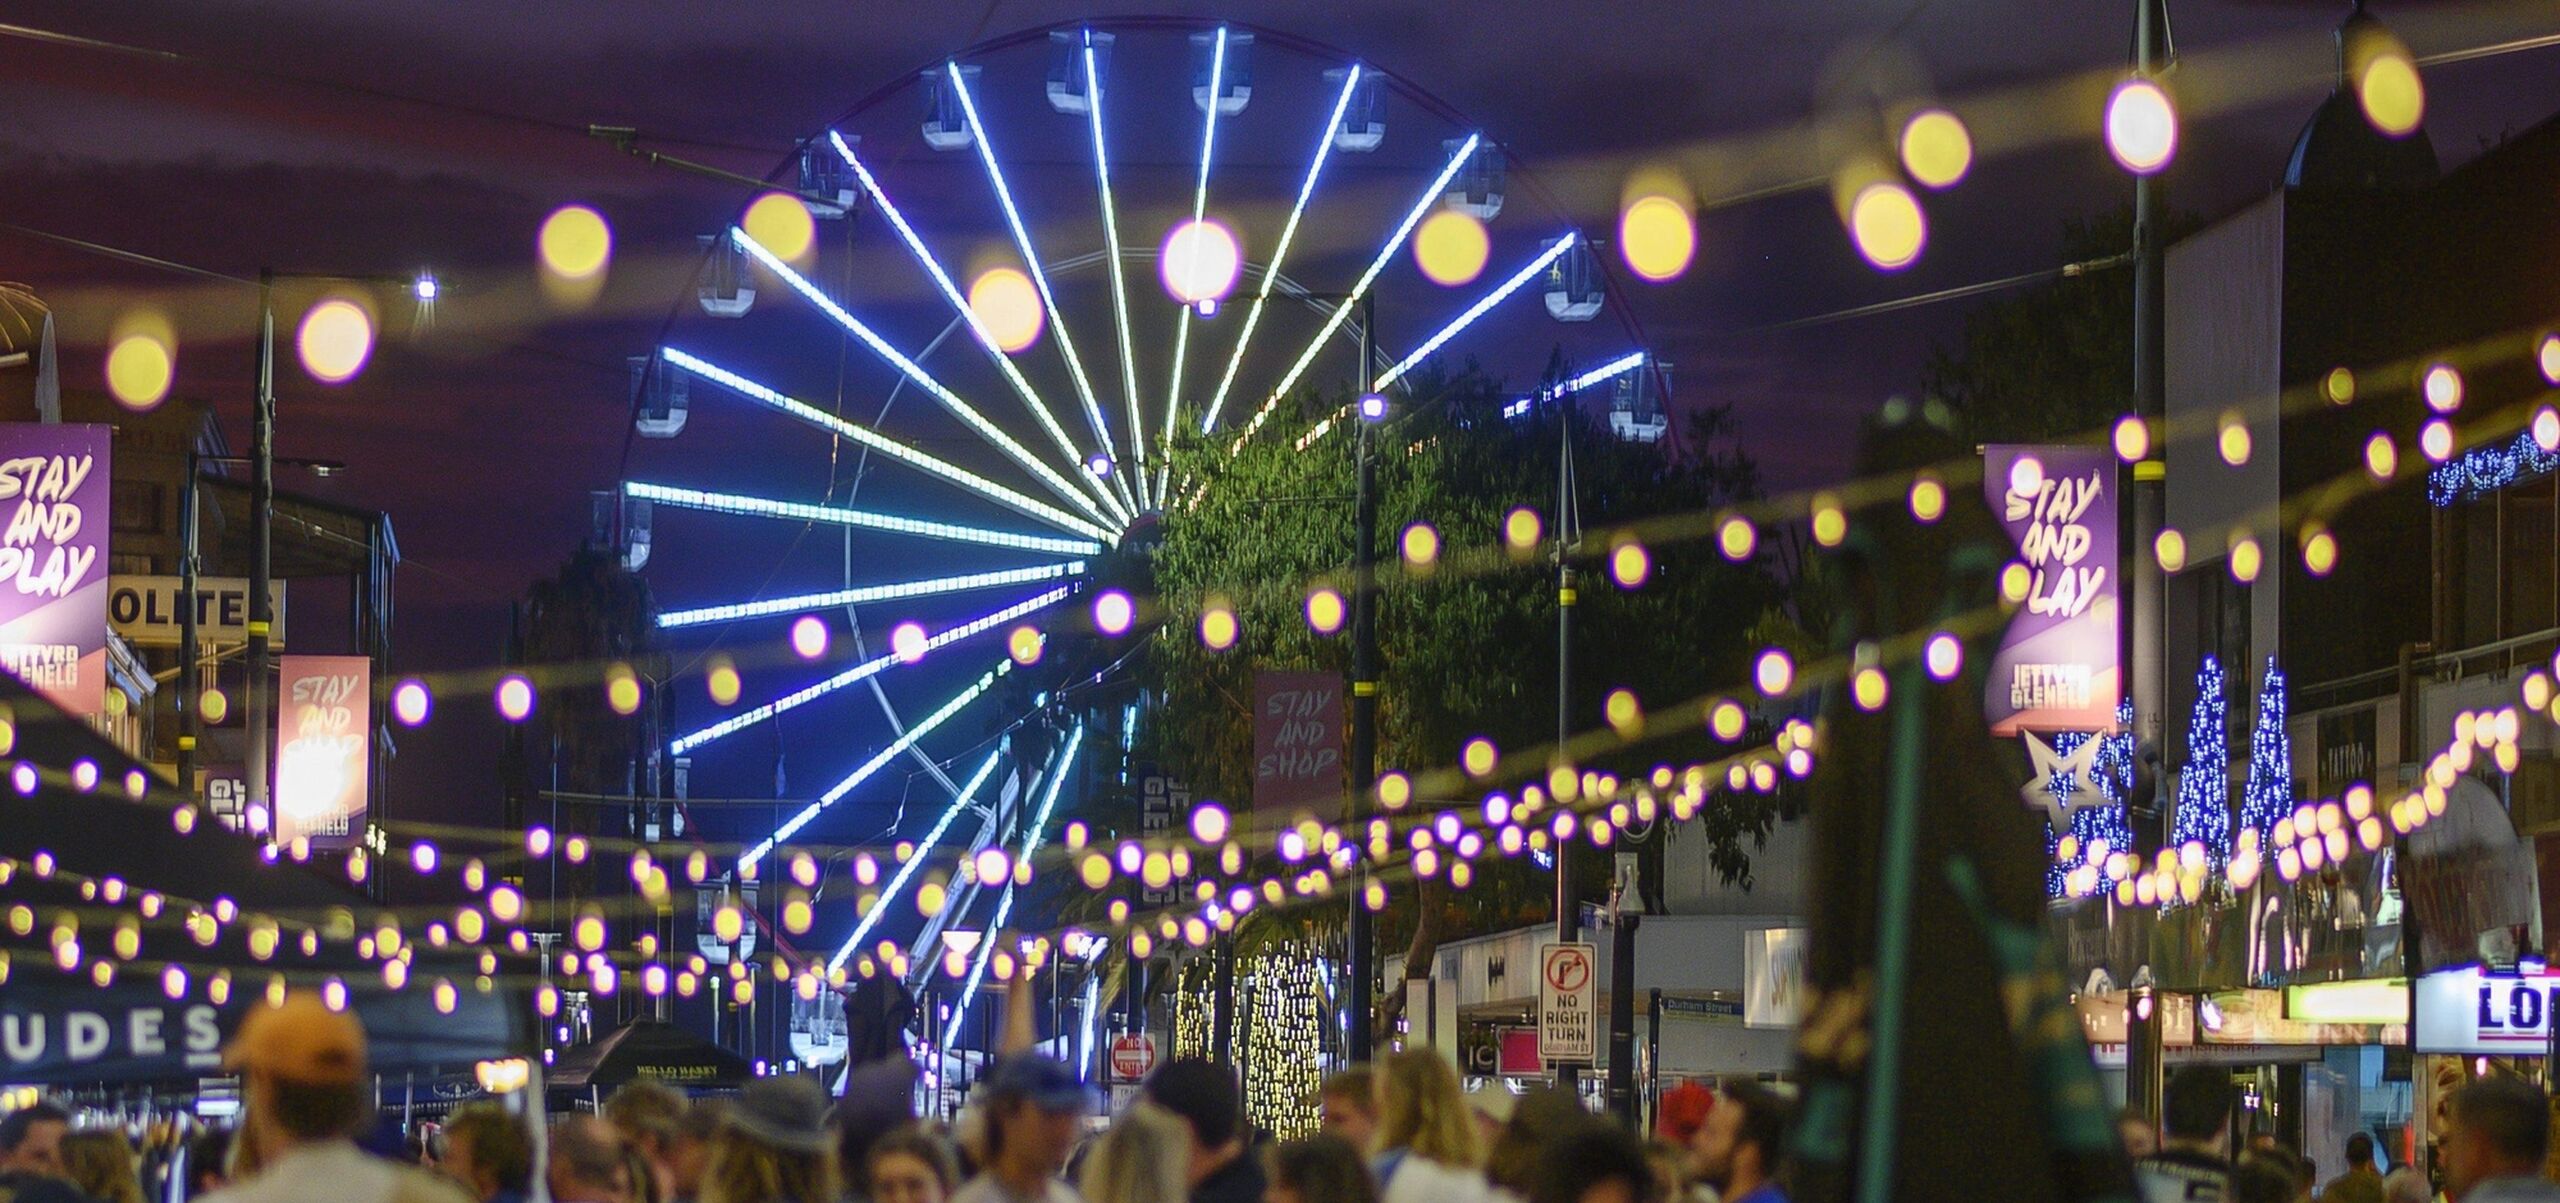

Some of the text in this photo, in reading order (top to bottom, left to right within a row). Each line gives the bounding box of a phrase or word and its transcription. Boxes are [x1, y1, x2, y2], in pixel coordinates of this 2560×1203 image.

[0, 454, 93, 502] STAY
[2005, 476, 2101, 523] STAY
[4, 499, 81, 548] AND
[2021, 520, 2091, 568] AND
[111, 587, 274, 626] OLITE
[2027, 566, 2106, 618] LAY
[293, 674, 360, 705] STAY
[1266, 689, 1332, 718] STAY
[1273, 719, 1325, 748] AND
[1258, 748, 1338, 779] SHOP
[2328, 742, 2364, 781] TATTOO
[1546, 1011, 1588, 1026] RIGHT
[1557, 994, 1578, 1009] NO
[1548, 1027, 1586, 1042] TURN
